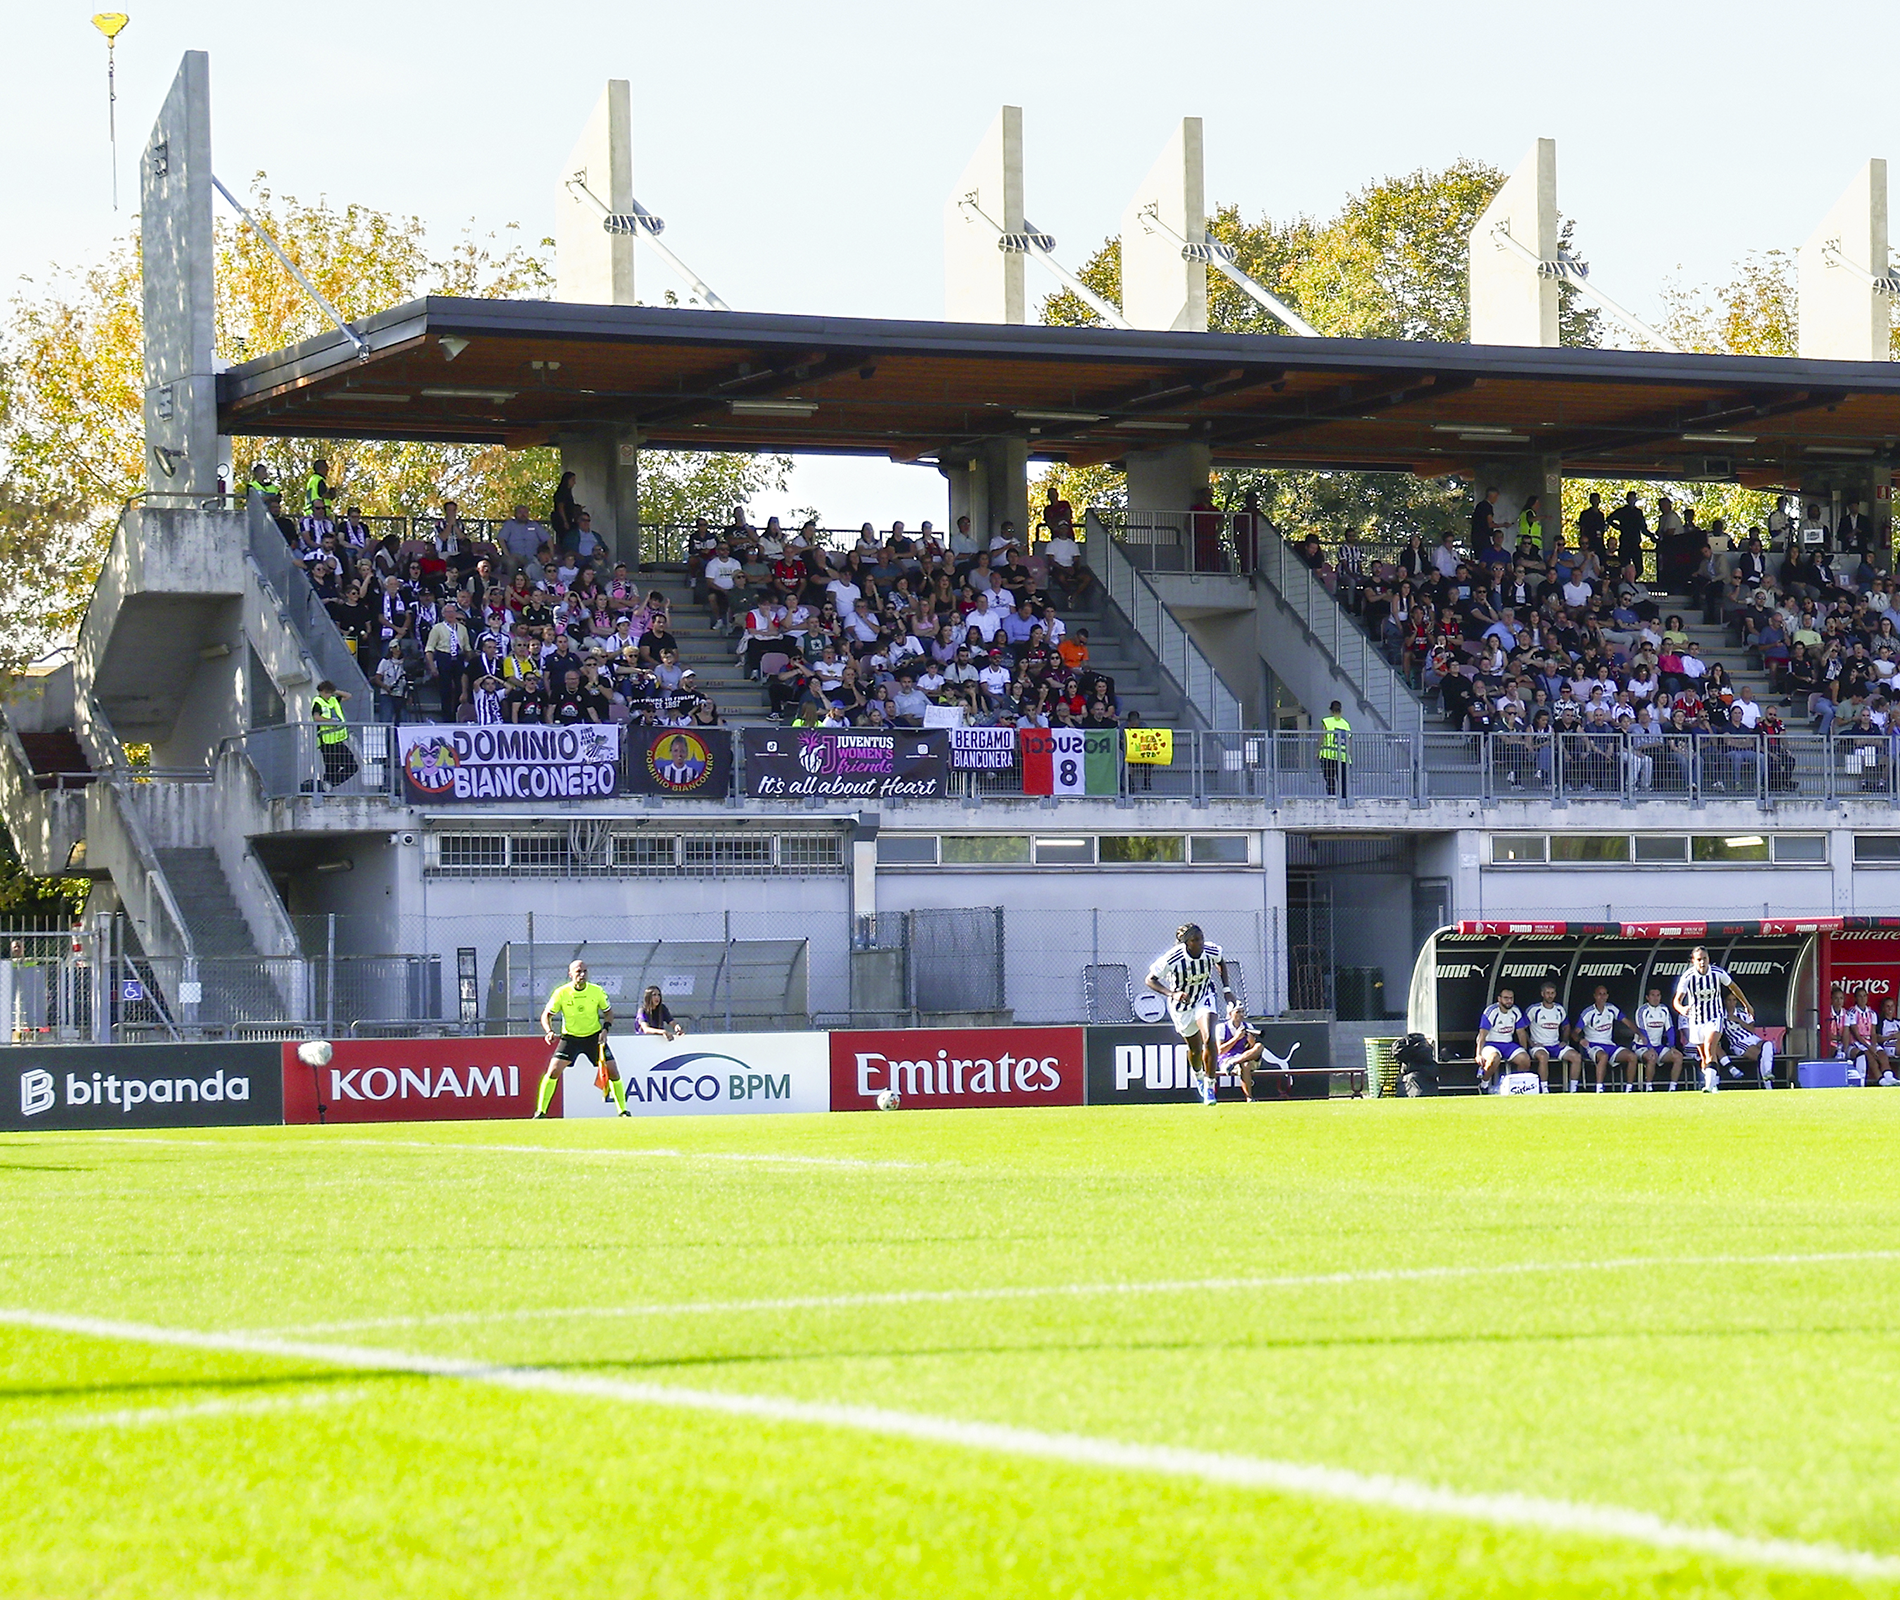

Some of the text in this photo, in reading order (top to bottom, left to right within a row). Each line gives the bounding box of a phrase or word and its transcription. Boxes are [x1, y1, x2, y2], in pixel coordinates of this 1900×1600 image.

[453, 729, 579, 761] DOMINIO
[836, 735, 894, 749] JUVENTUS
[955, 730, 1011, 749] BERGAMO
[837, 748, 894, 759] WOMEN'S
[953, 750, 1014, 769] BIANCONERA
[671, 752, 714, 792] BIANCONERO
[836, 758, 894, 775] friends
[454, 763, 616, 798] BIANCONERO
[757, 775, 938, 797] It's all about Heart
[1509, 924, 1533, 933] PUMA
[1659, 927, 1682, 936] PUMA
[1795, 924, 1818, 932] PUMA
[1436, 965, 1471, 978] UMA
[1501, 964, 1547, 978] PUMA
[1577, 964, 1623, 977] PUMA
[1652, 963, 1691, 976] PUM
[1727, 962, 1772, 975] PUMA
[1204, 998, 1211, 1007] 4
[854, 1048, 1062, 1097] Emirates
[331, 1064, 520, 1102] KONAMI
[605, 1073, 791, 1103] ANCO BPM
[65, 1069, 251, 1113] bitpanda
